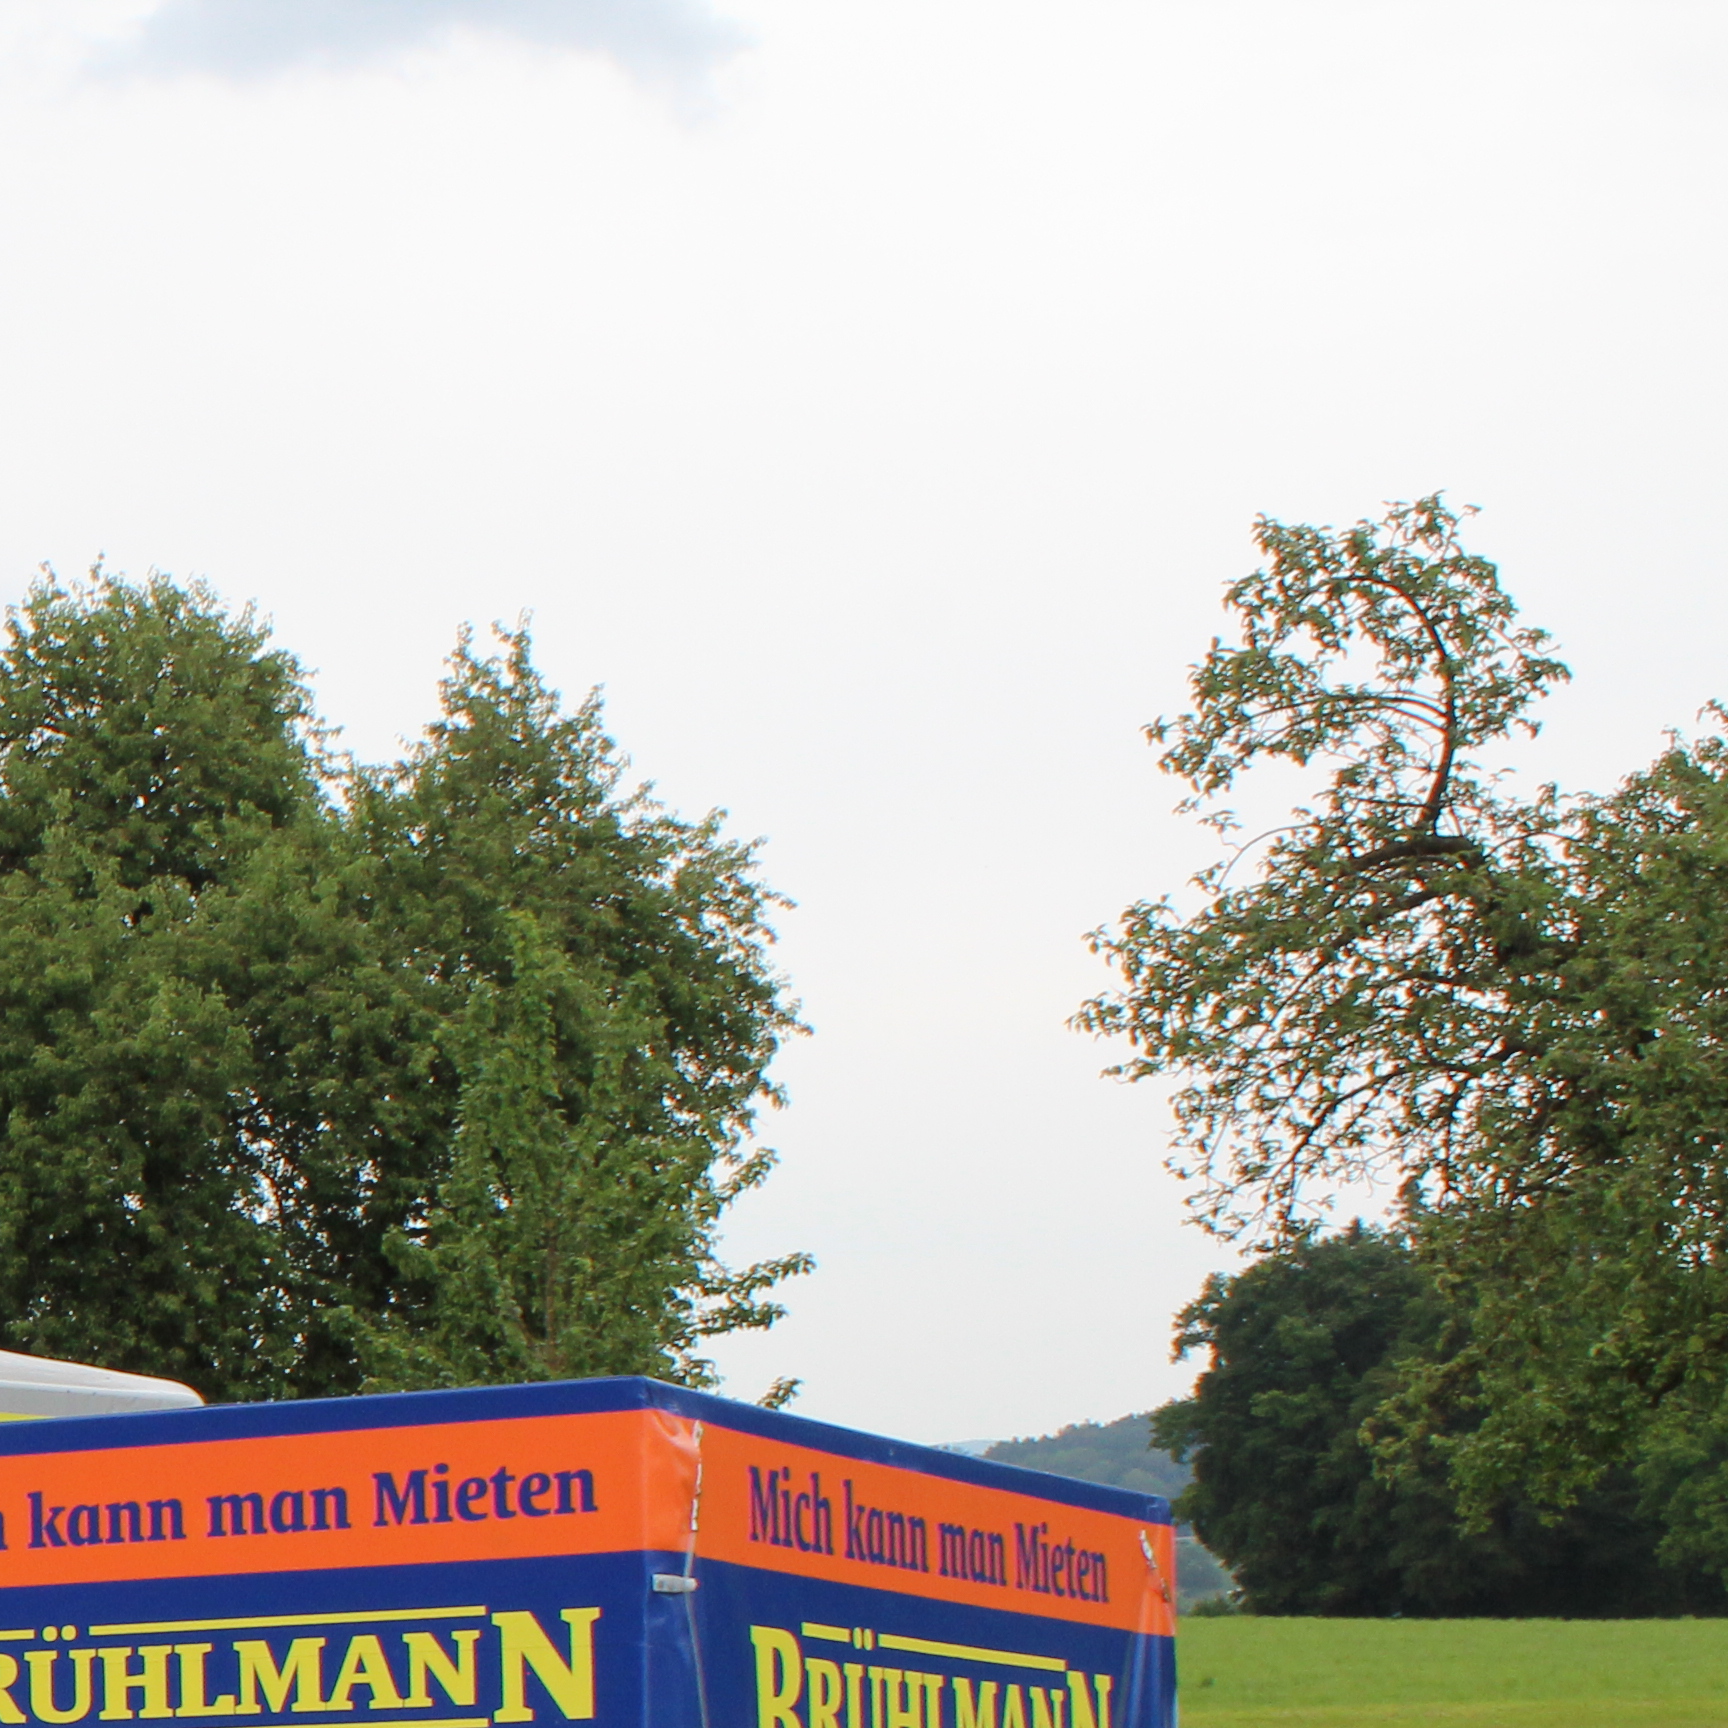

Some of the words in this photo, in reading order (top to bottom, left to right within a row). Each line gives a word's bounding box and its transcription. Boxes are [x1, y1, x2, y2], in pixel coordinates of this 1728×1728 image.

[28, 1491, 187, 1551] kann
[207, 1485, 351, 1539] man
[372, 1463, 599, 1526] Mieten
[749, 1465, 834, 1555] Mich
[844, 1479, 928, 1573] kann
[938, 1522, 1006, 1586] man
[1014, 1521, 1109, 1604] Mieten
